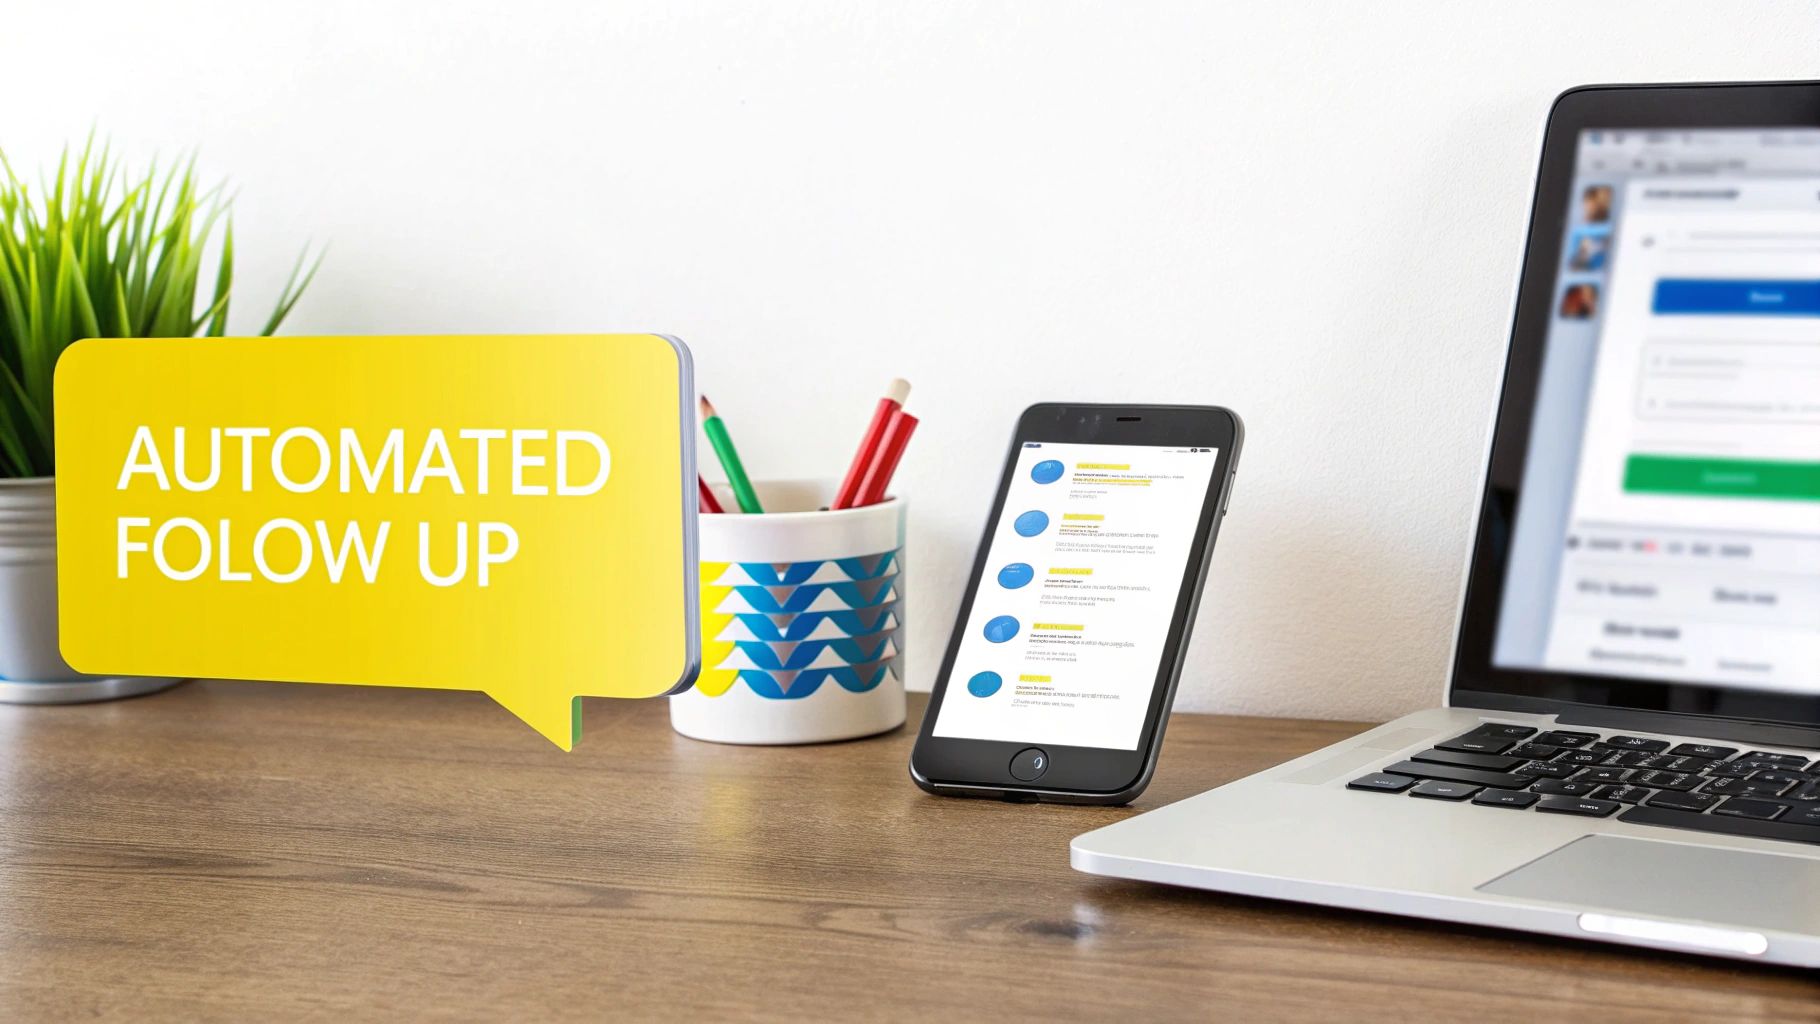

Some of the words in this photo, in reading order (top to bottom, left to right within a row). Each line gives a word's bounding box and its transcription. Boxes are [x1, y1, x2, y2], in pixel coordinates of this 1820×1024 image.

[116, 425, 612, 497] AUTOMATED
[117, 517, 391, 584] FOLOW
[418, 521, 520, 588] UP
